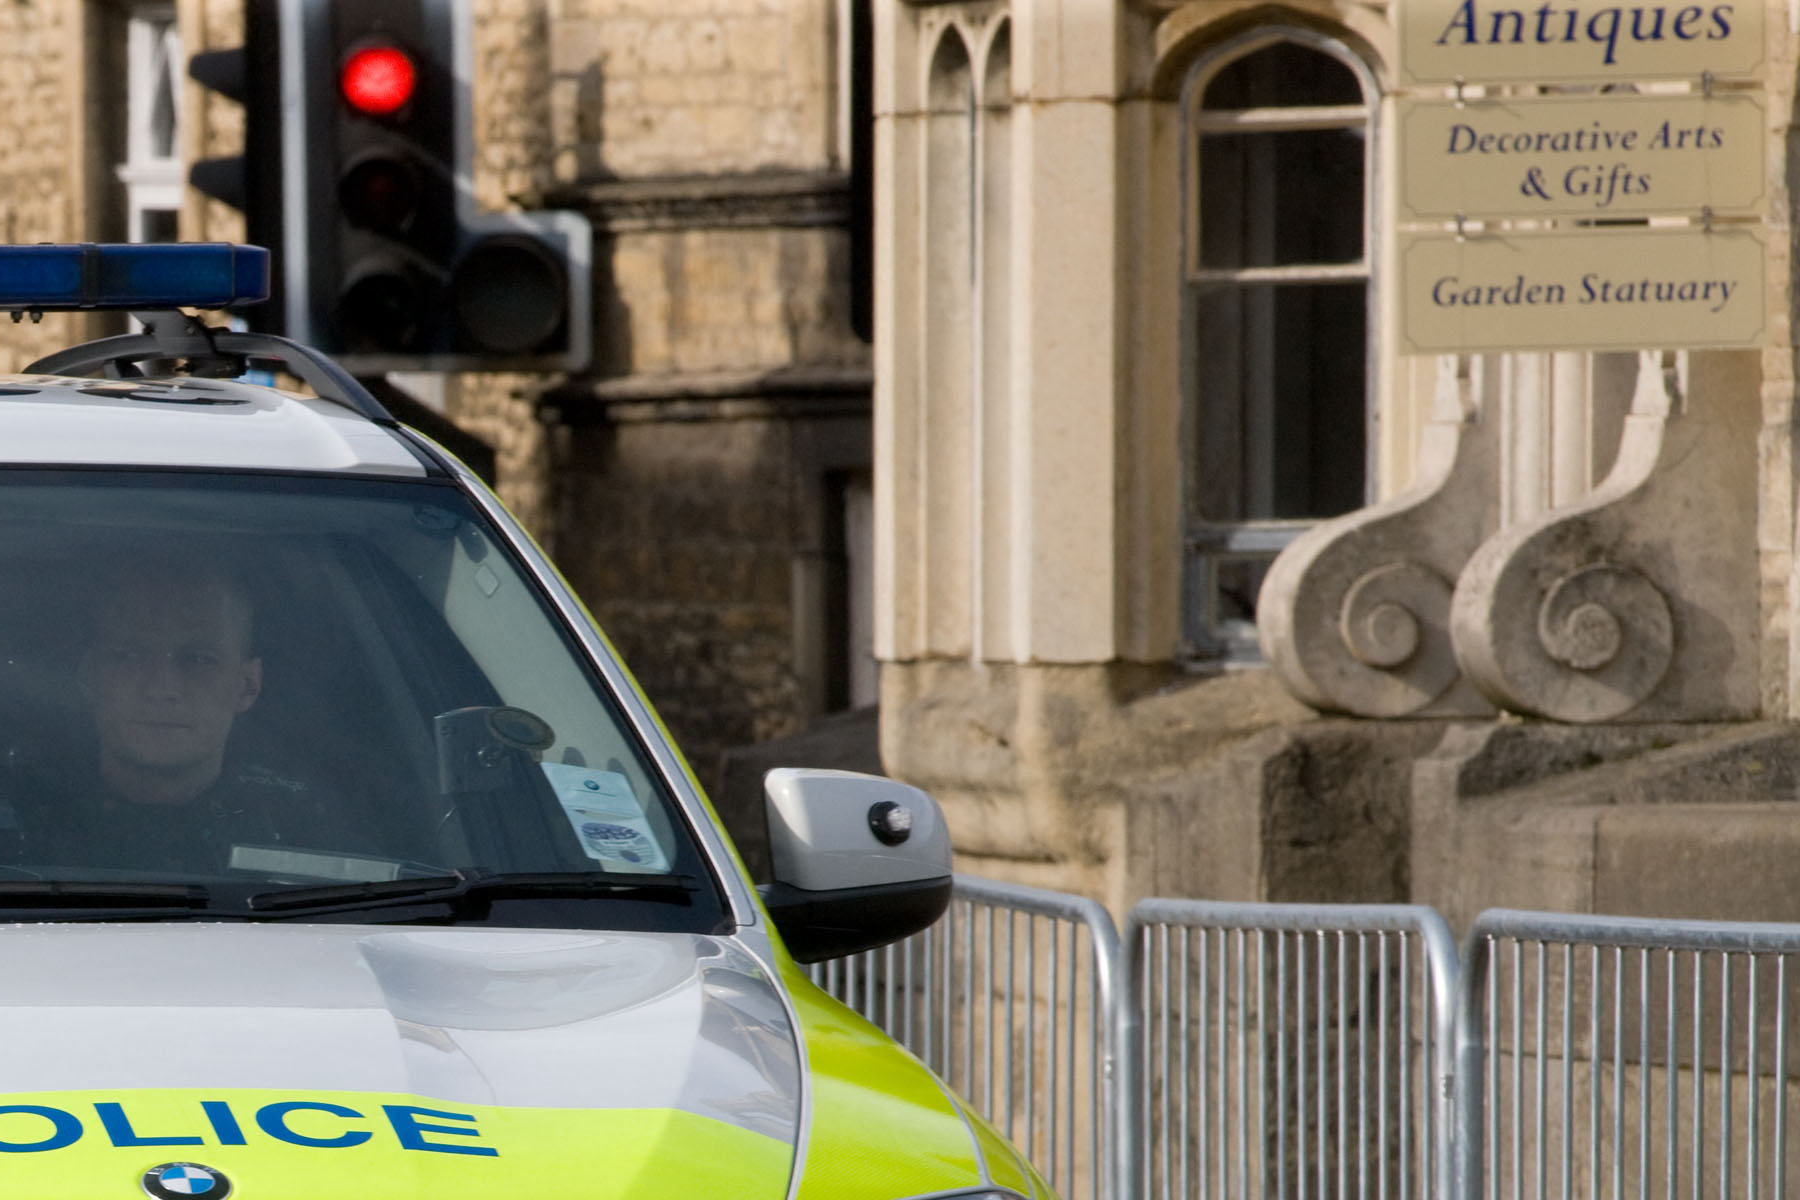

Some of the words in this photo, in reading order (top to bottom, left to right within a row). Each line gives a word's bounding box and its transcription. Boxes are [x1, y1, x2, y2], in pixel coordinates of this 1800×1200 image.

[1436, 0, 1734, 65] Antiques
[1446, 121, 1638, 155] Decorative
[1648, 120, 1725, 151] Arts
[1519, 167, 1553, 200] &
[1563, 163, 1652, 207] Gifts
[1431, 275, 1566, 308] Garden
[1578, 273, 1738, 313] Statuary
